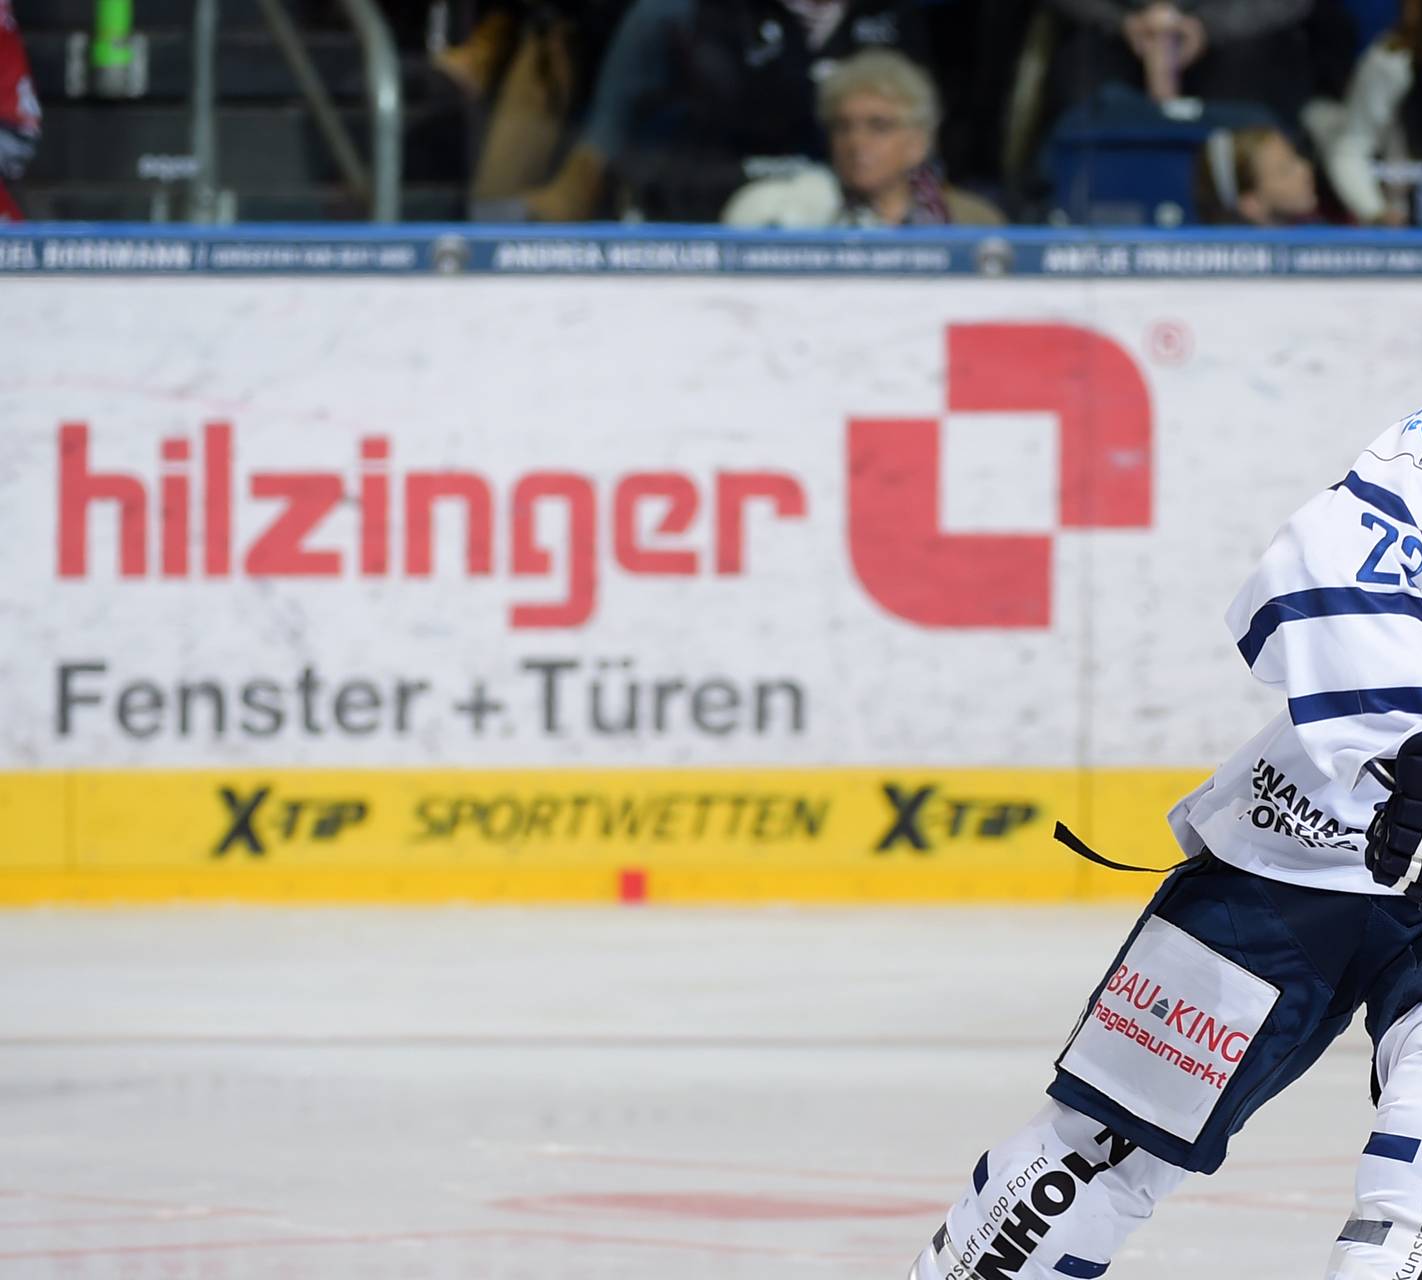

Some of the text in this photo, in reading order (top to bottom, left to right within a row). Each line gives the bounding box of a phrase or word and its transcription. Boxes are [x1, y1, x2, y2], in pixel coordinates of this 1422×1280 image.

[56, 422, 808, 628] hilzinger
[56, 660, 430, 736] Fenster
[520, 659, 806, 737] Türen
[411, 790, 832, 843] SPORTWETTEN
[977, 1222, 995, 1240] in
[989, 1196, 1010, 1223] top
[1006, 1155, 1049, 1197] Form
